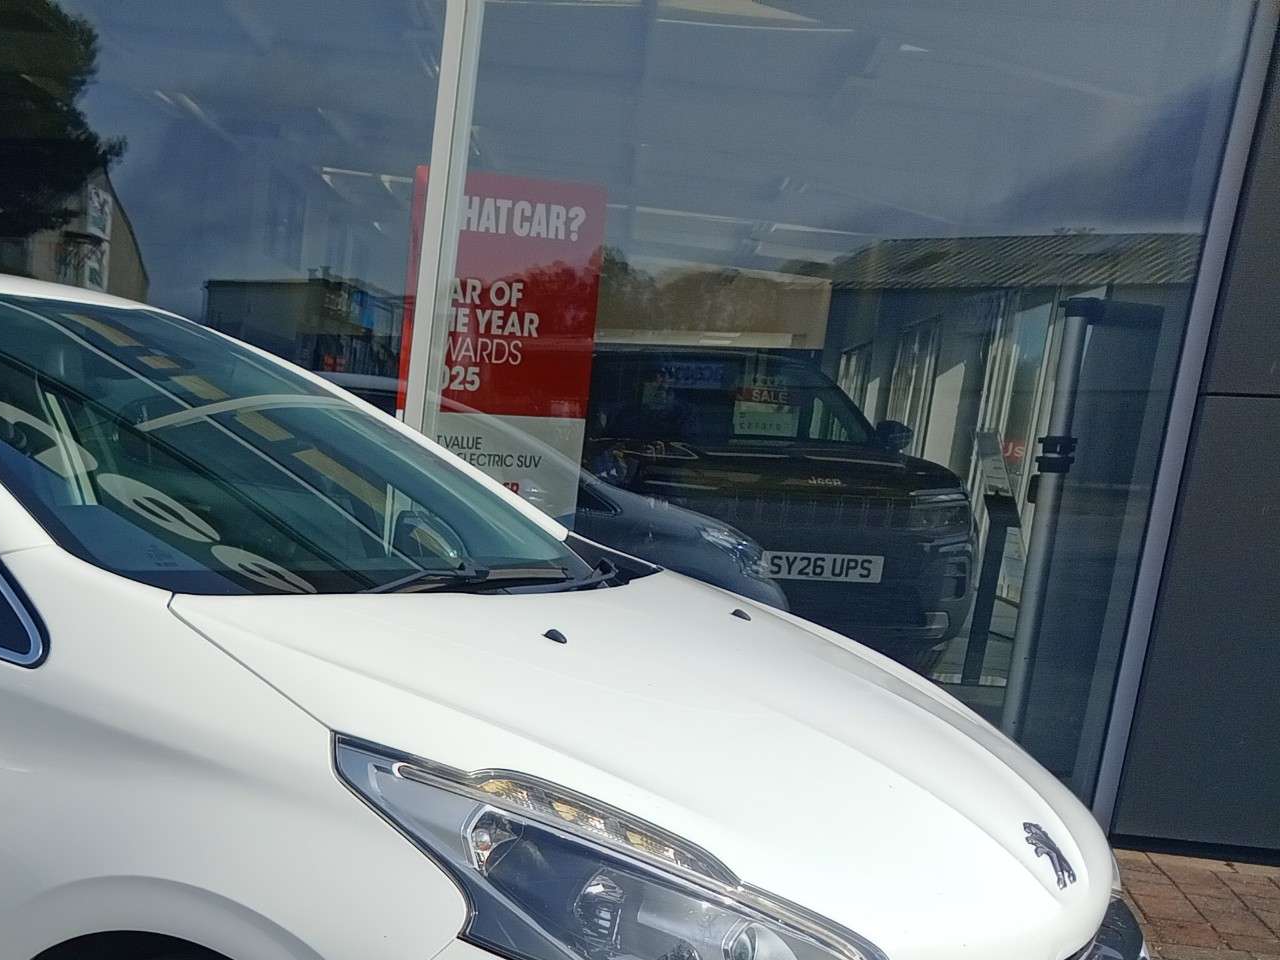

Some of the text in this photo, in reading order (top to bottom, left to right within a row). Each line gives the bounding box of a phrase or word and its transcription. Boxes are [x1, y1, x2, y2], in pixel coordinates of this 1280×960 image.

[489, 280, 524, 308] OF
[476, 308, 540, 338] YEAR
[443, 434, 483, 451] VALUE
[516, 454, 543, 469] SUV
[769, 555, 873, 579] SY26 UPS
